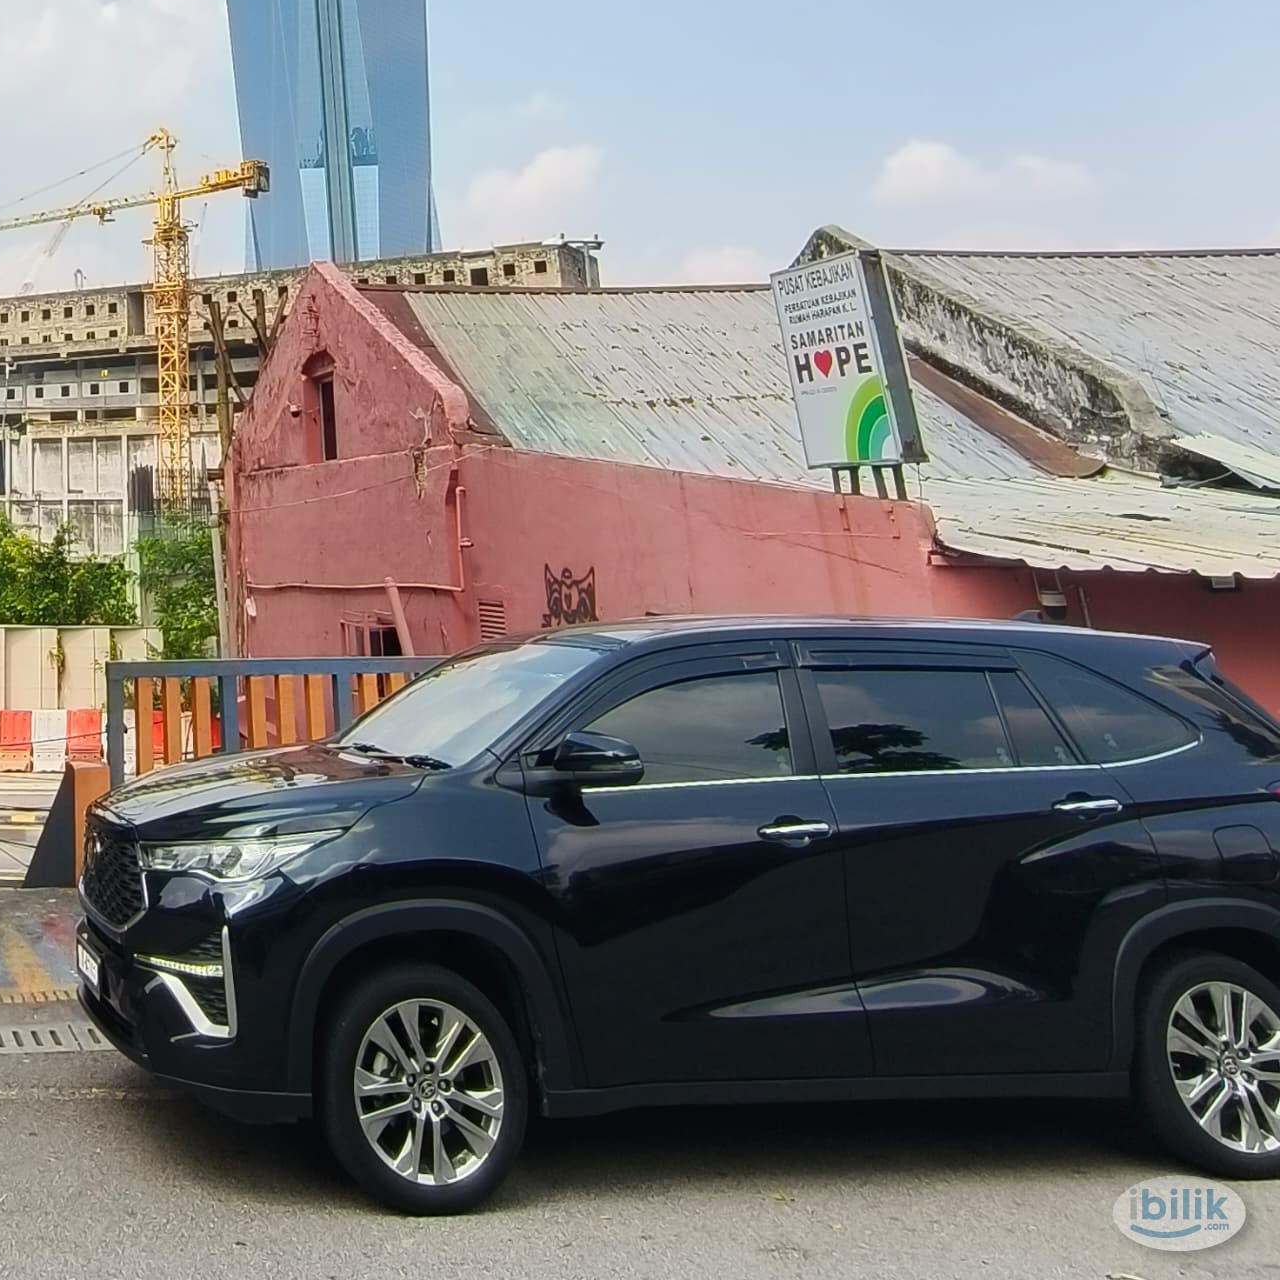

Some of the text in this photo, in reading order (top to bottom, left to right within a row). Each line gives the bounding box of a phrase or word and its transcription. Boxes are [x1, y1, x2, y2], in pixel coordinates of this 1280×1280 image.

[778, 262, 854, 296] PUSAT KEBAJIKAN
[790, 320, 865, 350] SAMARITAN
